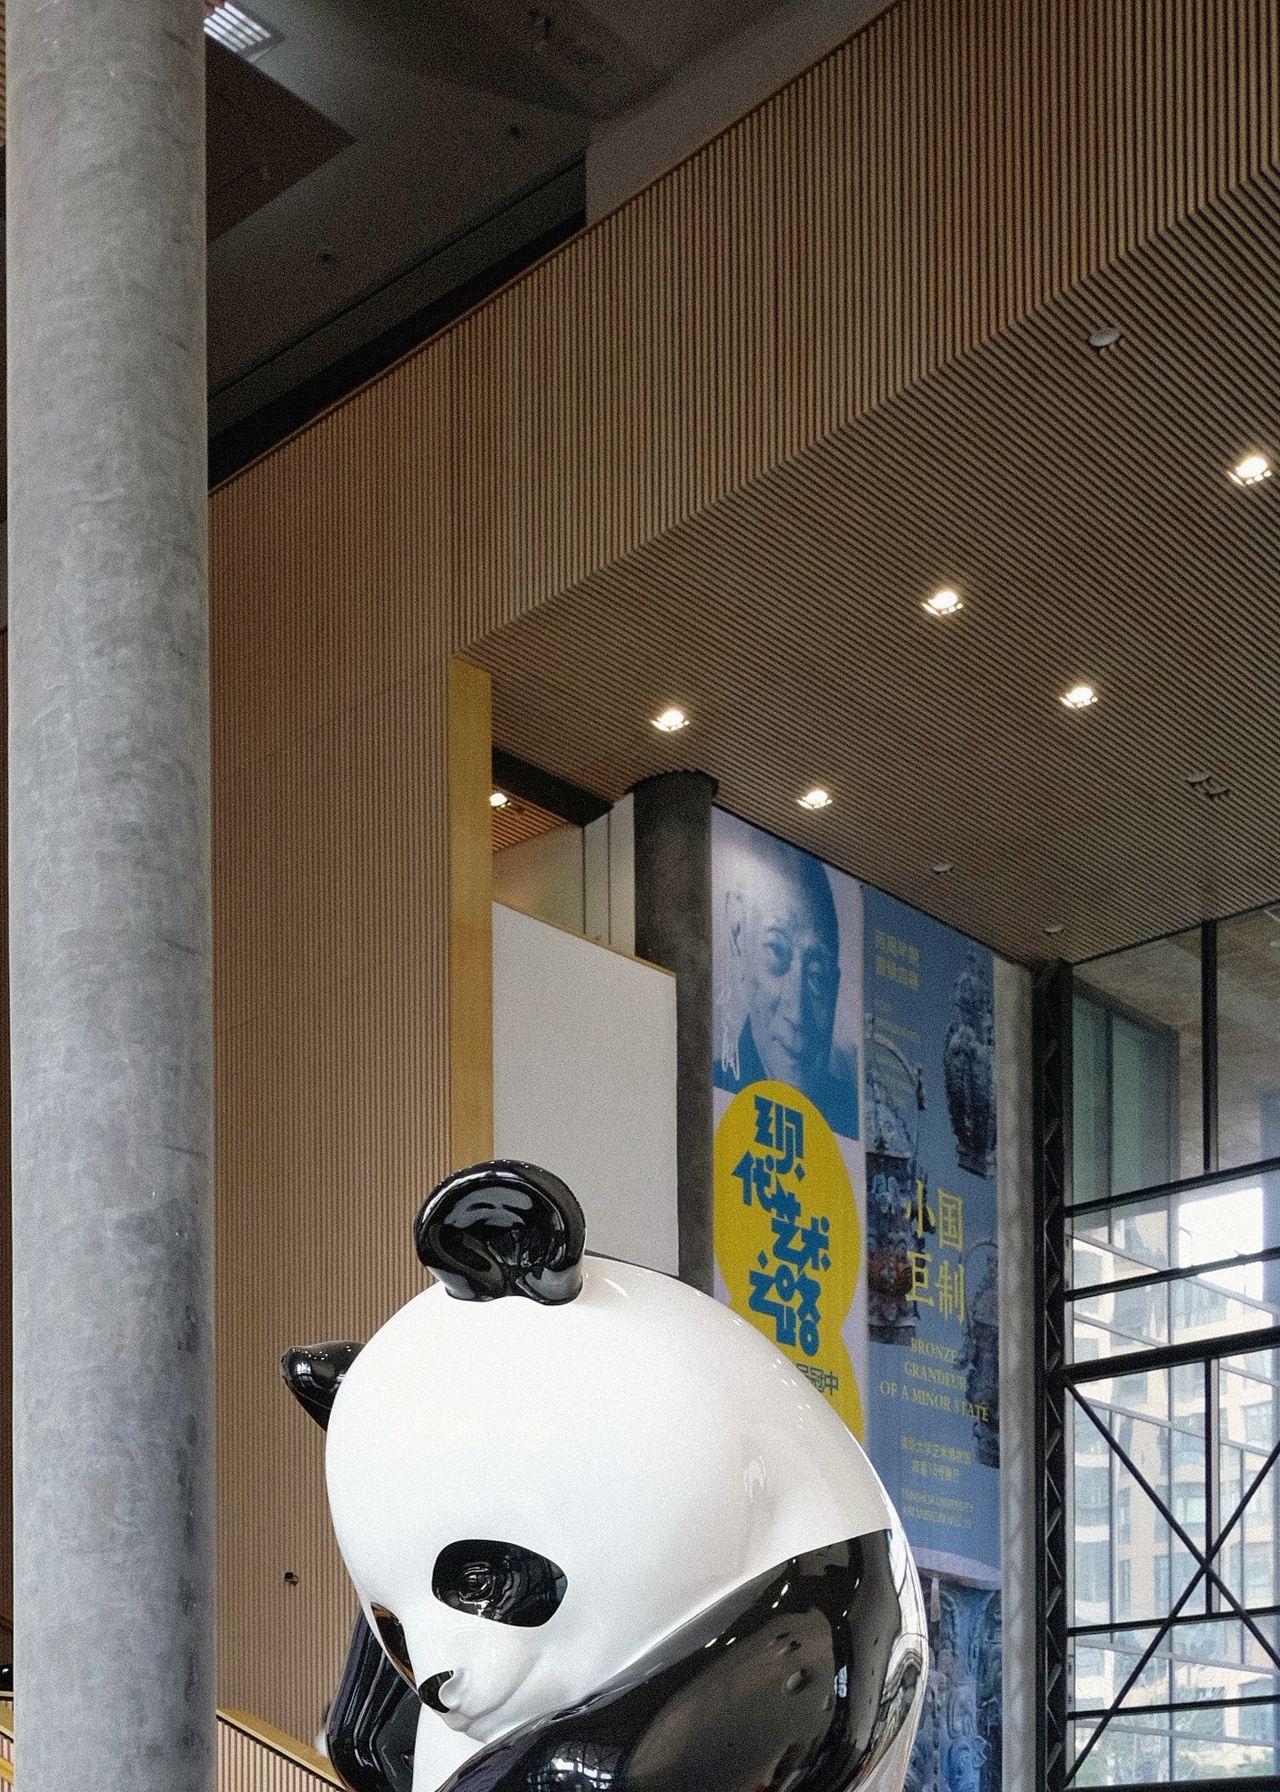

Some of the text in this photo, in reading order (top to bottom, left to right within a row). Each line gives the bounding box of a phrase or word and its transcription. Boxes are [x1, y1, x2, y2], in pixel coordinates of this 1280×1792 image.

[906, 1178, 964, 1251] 小国
[905, 1250, 966, 1324] 巨制
[910, 1337, 959, 1364] BRONZE
[903, 1361, 968, 1392] GRANDEUR
[880, 1380, 989, 1422] OF A MINOR STATE
